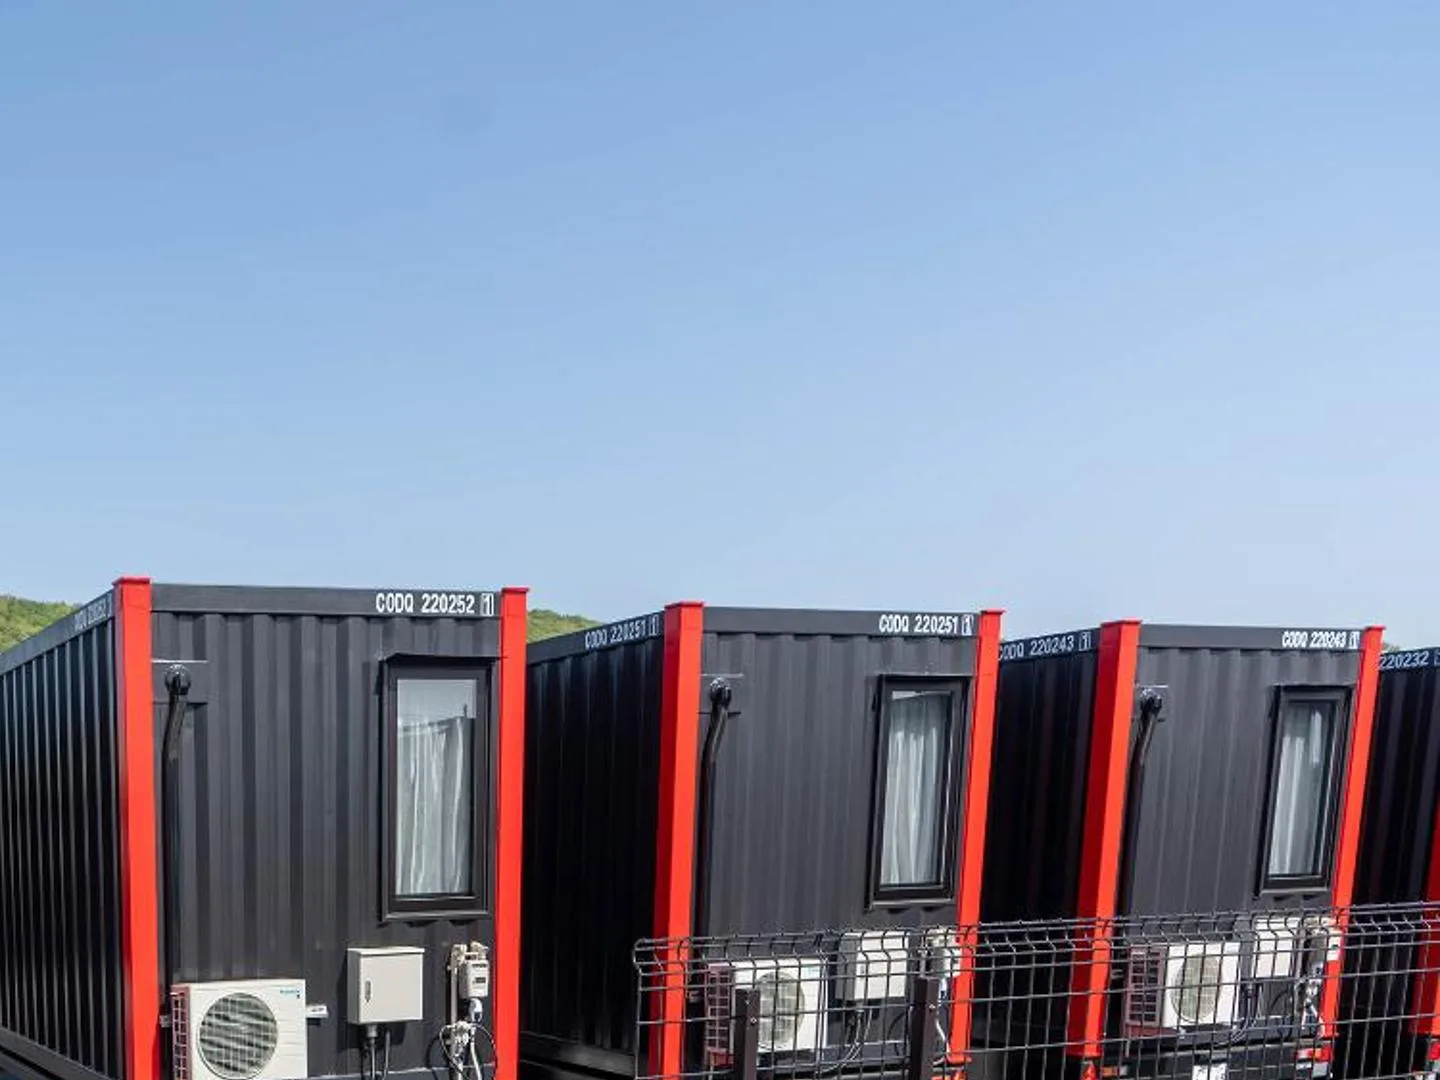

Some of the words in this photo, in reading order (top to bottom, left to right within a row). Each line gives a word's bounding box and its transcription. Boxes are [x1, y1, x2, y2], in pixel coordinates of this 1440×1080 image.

[375, 593, 414, 613] CODQ
[421, 593, 475, 614] 220252
[879, 614, 909, 633] CODQ
[914, 614, 959, 634] 220251
[1030, 635, 1074, 656] 220243
[1379, 650, 1429, 669] 220232
